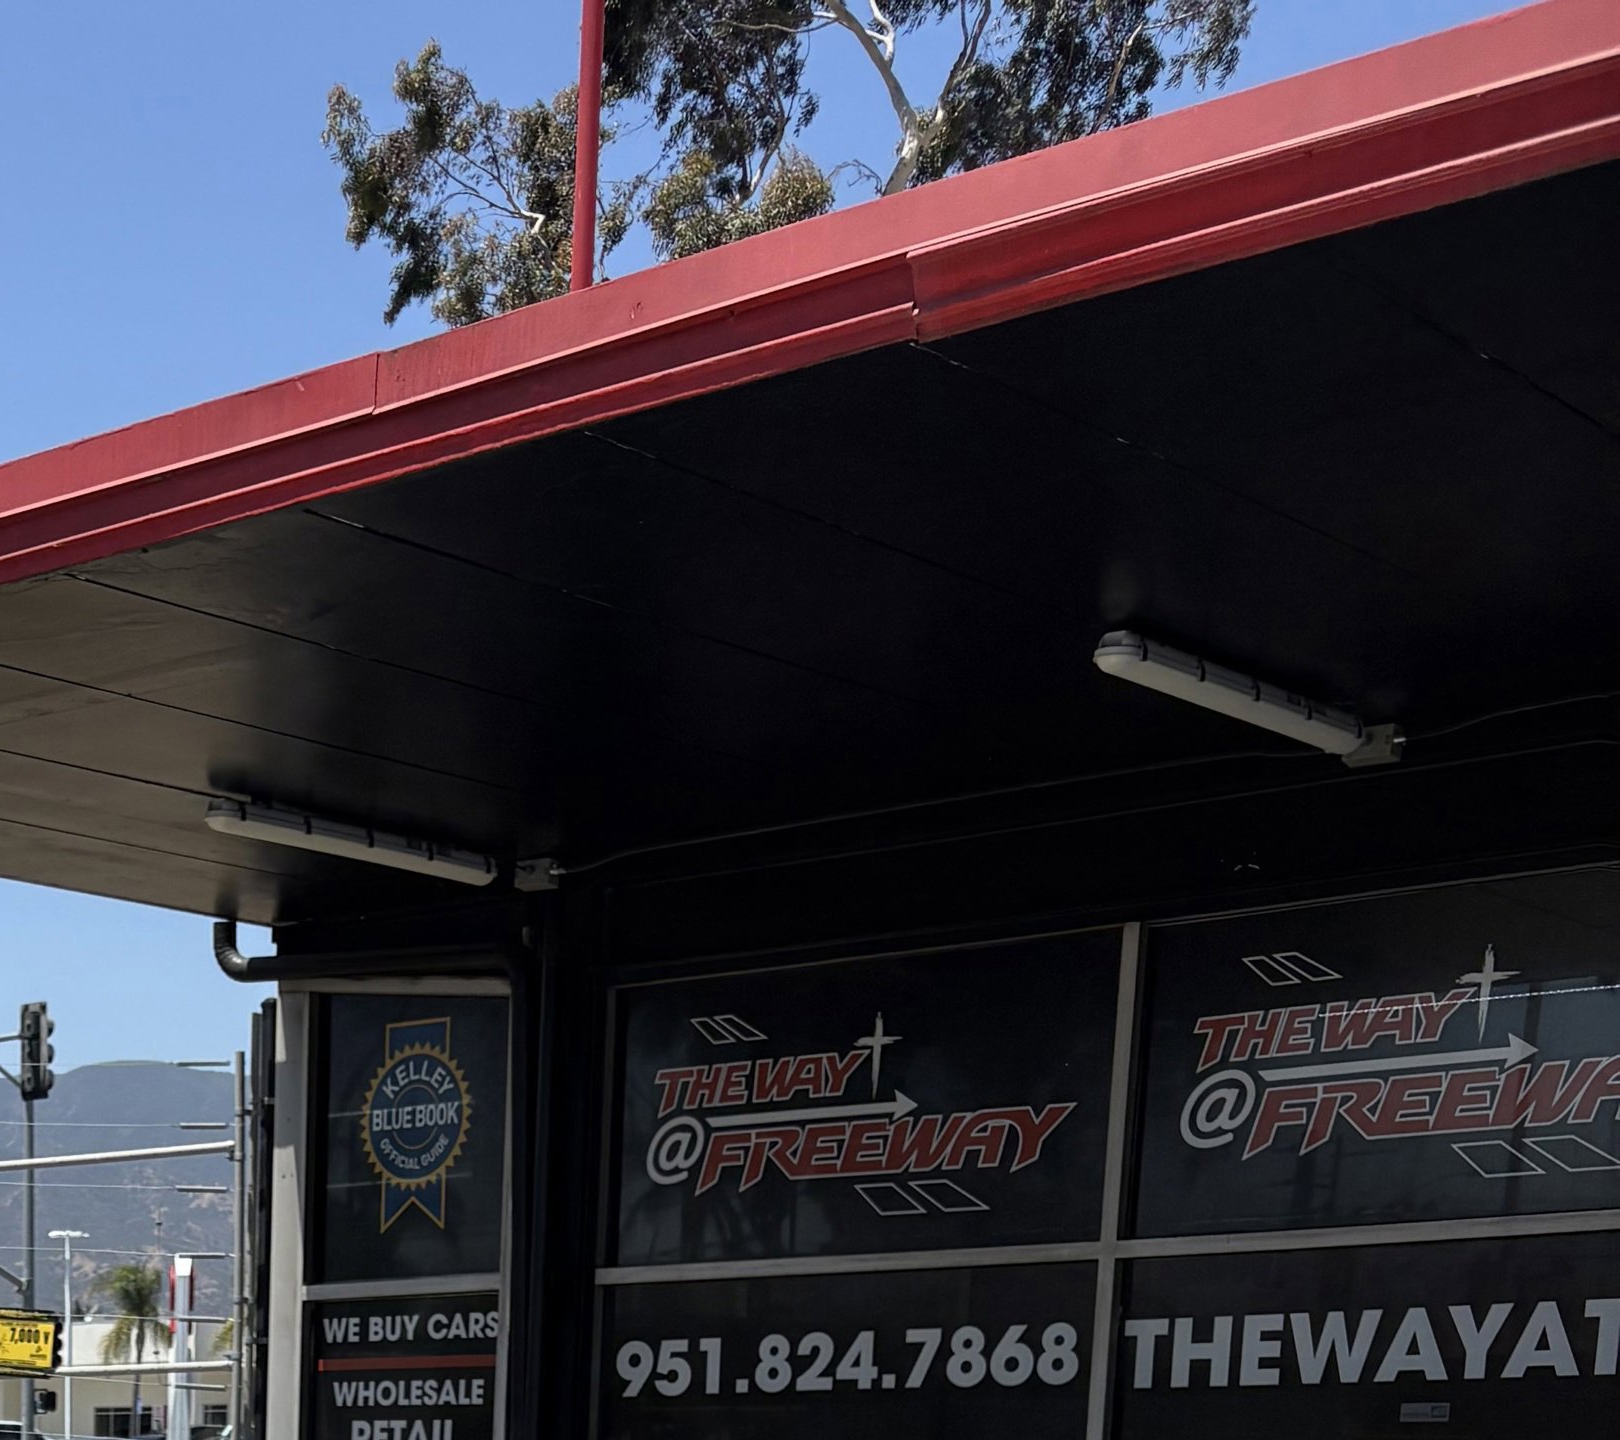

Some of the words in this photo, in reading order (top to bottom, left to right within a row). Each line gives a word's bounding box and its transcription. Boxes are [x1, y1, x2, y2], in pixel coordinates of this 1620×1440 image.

[382, 1059, 454, 1099] KELLEY
[372, 1106, 412, 1132] BLUE
[415, 1101, 460, 1129] BOOK
[380, 1138, 420, 1170] OFFICIAL
[420, 1133, 450, 1167] GUIDE
[10, 1327, 40, 1344] 7,000
[43, 1331, 51, 1345] V
[323, 1317, 360, 1343] WE
[368, 1314, 419, 1342] BUY
[427, 1311, 500, 1340] CARS
[616, 1321, 1079, 1398] 951.824.7868
[333, 1378, 485, 1407] WHOLESALE
